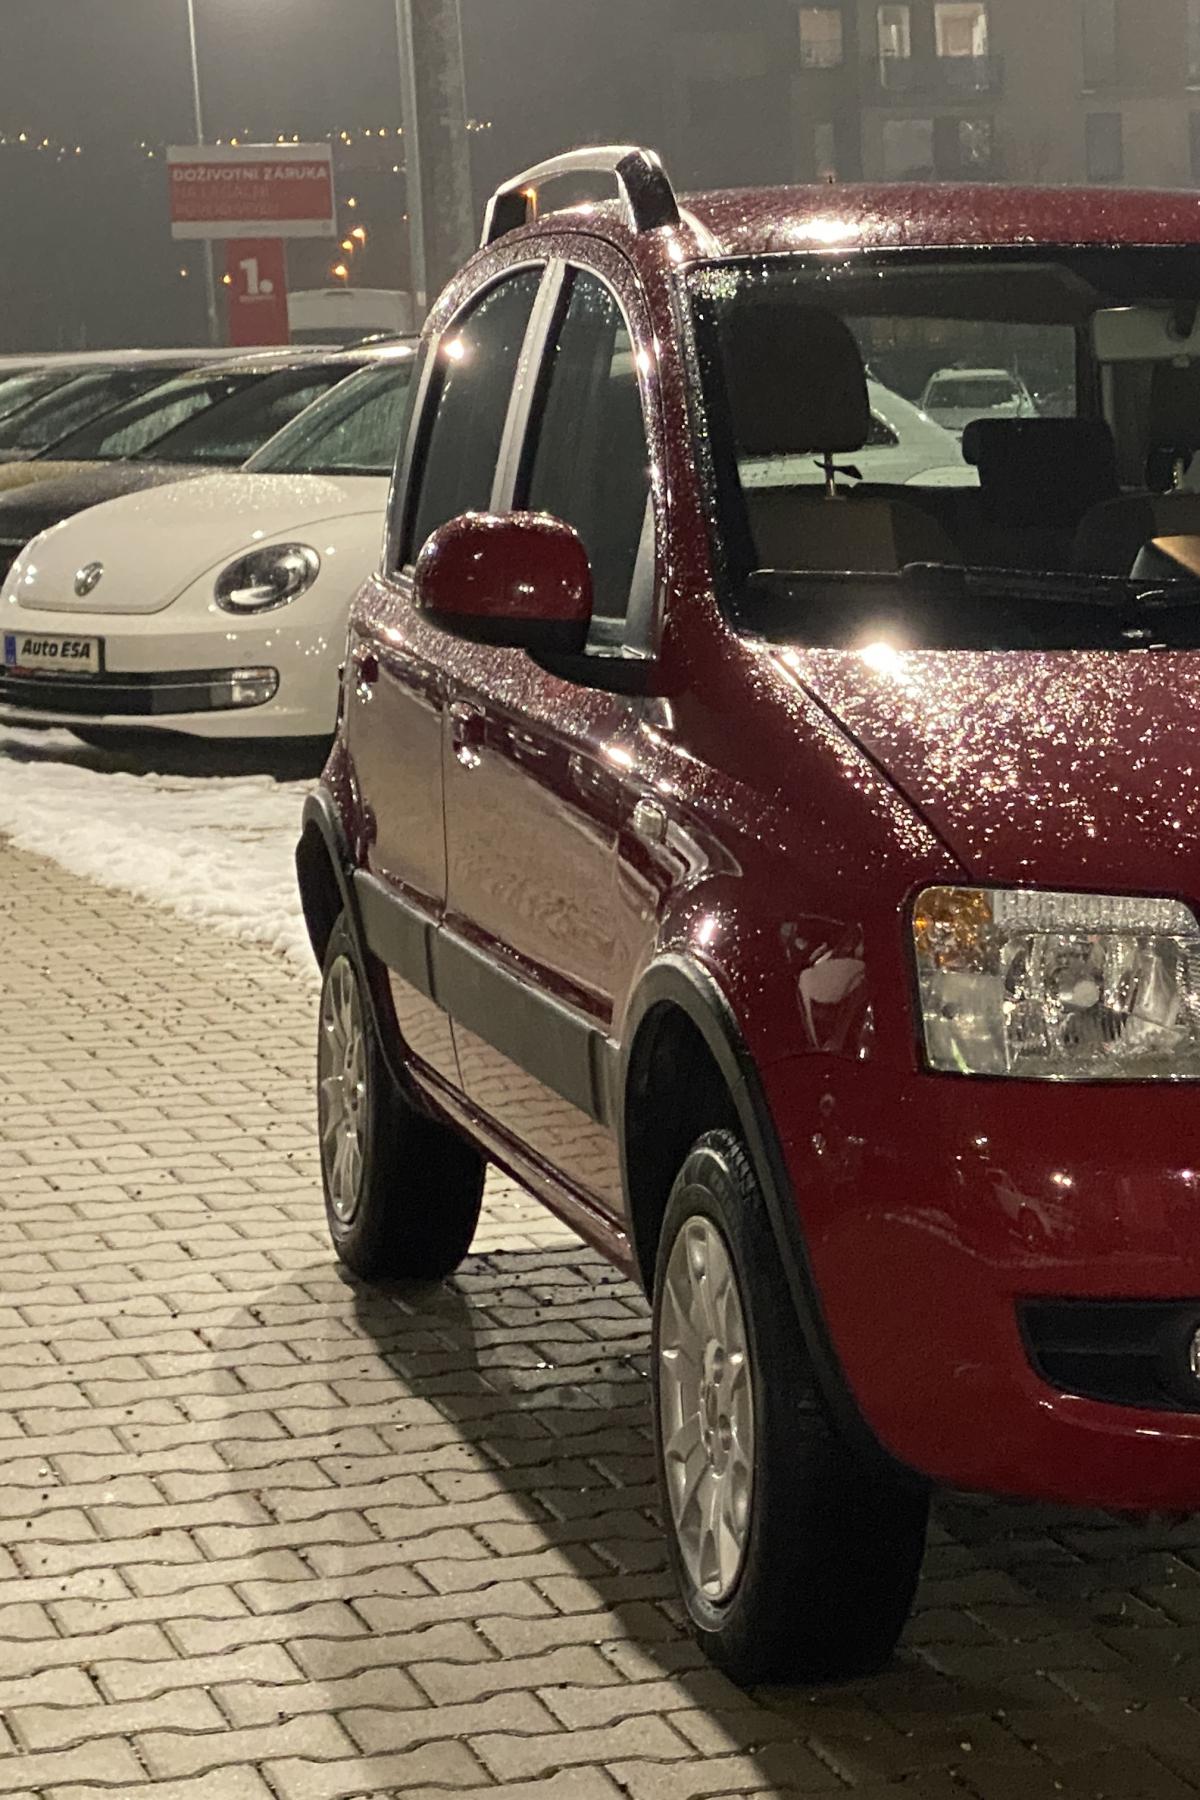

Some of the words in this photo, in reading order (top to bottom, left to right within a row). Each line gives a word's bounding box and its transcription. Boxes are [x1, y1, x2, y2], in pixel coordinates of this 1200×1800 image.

[239, 258, 273, 295] 1.
[21, 639, 59, 657] Auto
[60, 641, 91, 658] ESA
